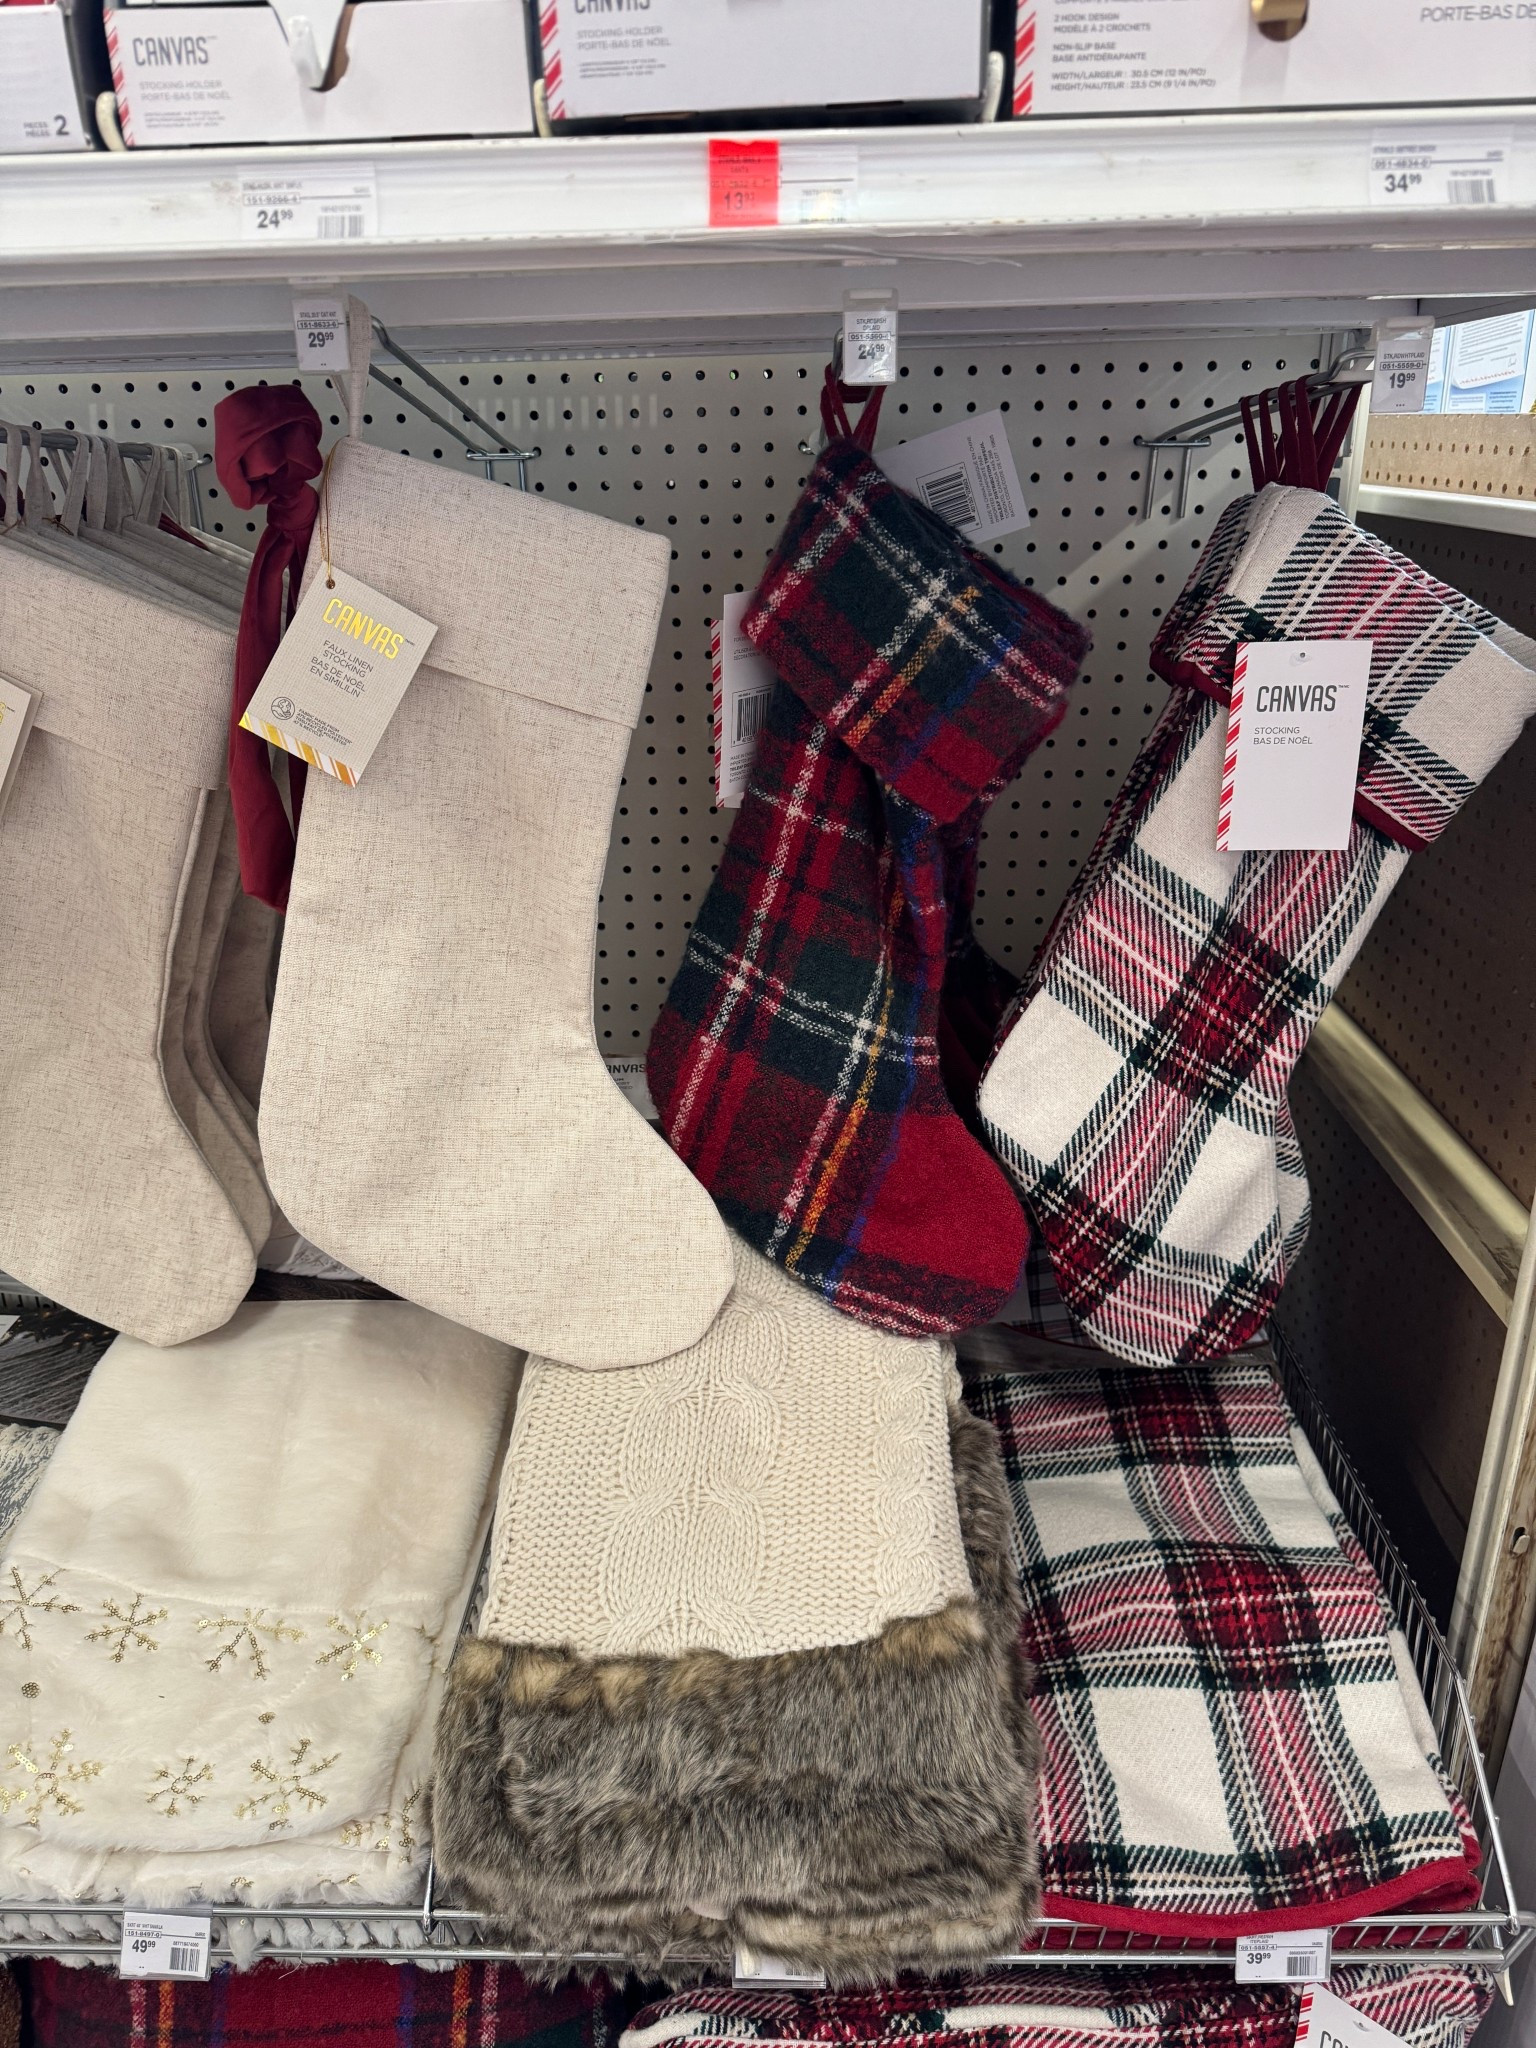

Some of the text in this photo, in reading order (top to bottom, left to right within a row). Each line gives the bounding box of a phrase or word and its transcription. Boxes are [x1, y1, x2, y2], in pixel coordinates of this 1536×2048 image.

[1088, 12, 1120, 20] DESIGN
[1420, 5, 1513, 22] PORTE-BAS
[1106, 23, 1151, 32] CROCHETS
[132, 36, 208, 66] CANVAS
[1053, 42, 1116, 51] NON-SLIP BASE
[1052, 53, 1074, 62] BASE
[1052, 71, 1122, 80] WIDTH/LARGEUR
[1051, 81, 1125, 91] HEIGHT/HAUTEUR
[54, 114, 69, 136] 2
[323, 598, 404, 659] CANVAS
[322, 649, 366, 678] STOCKING
[323, 639, 374, 672] FAUX LINEN
[311, 656, 329, 671] BAS
[330, 667, 342, 679] DE
[310, 665, 361, 698] EN SIMILILIN
[1256, 685, 1337, 712] CANVAS
[298, 708, 314, 719] FABRIC
[313, 716, 326, 725] MADE
[305, 717, 328, 731] RECYCLED
[1254, 726, 1300, 735] STOCKING
[1253, 737, 1271, 745] BAS
[1273, 737, 1286, 745] DE
